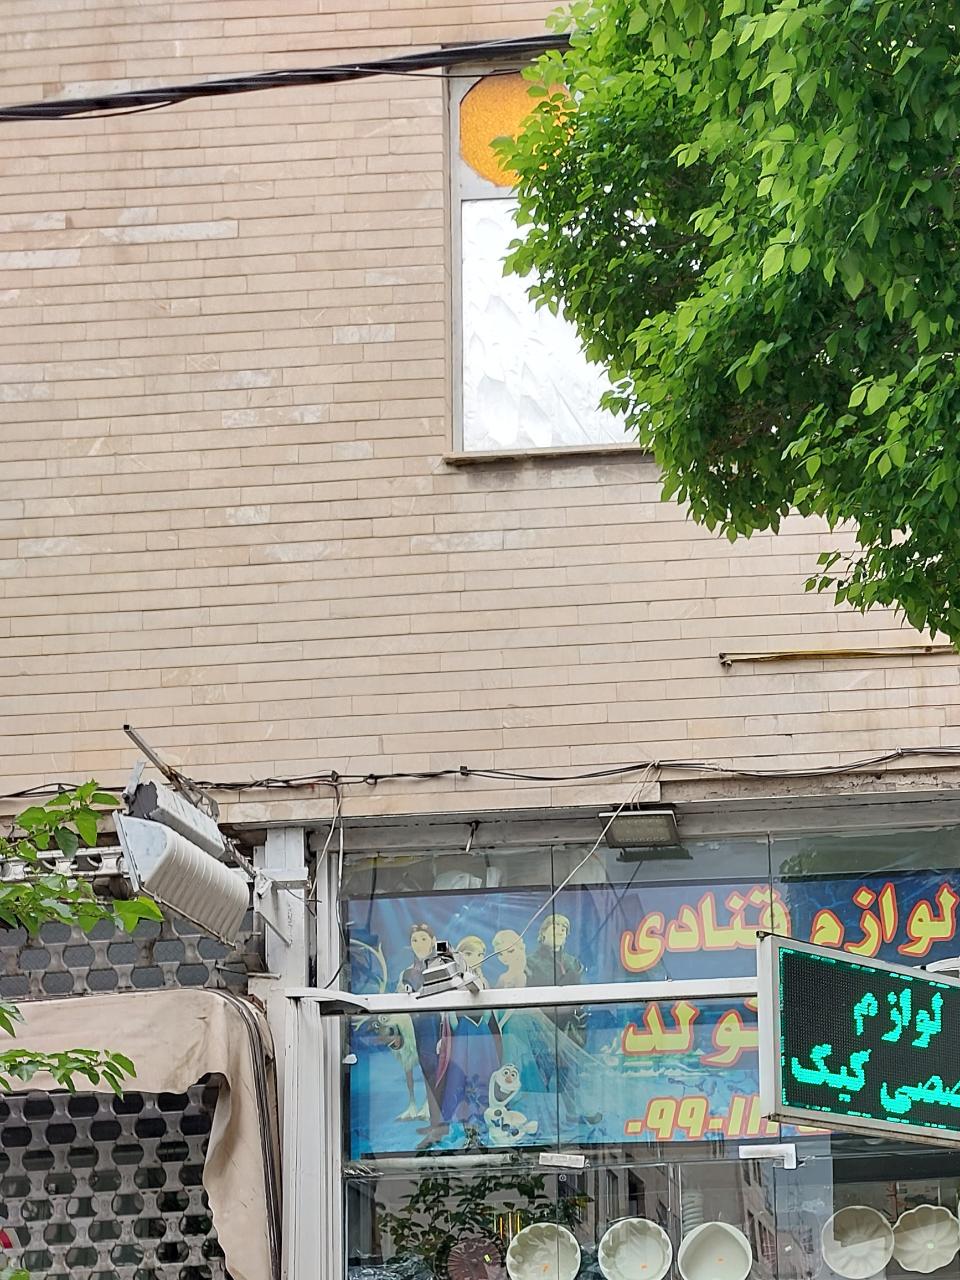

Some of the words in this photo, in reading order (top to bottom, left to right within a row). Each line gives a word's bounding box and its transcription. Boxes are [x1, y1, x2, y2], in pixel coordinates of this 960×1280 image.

[620, 885, 792, 973] قنادی
[810, 882, 960, 959] لوازم
[854, 988, 943, 1048] لوازم
[791, 1044, 872, 1103] کیک
